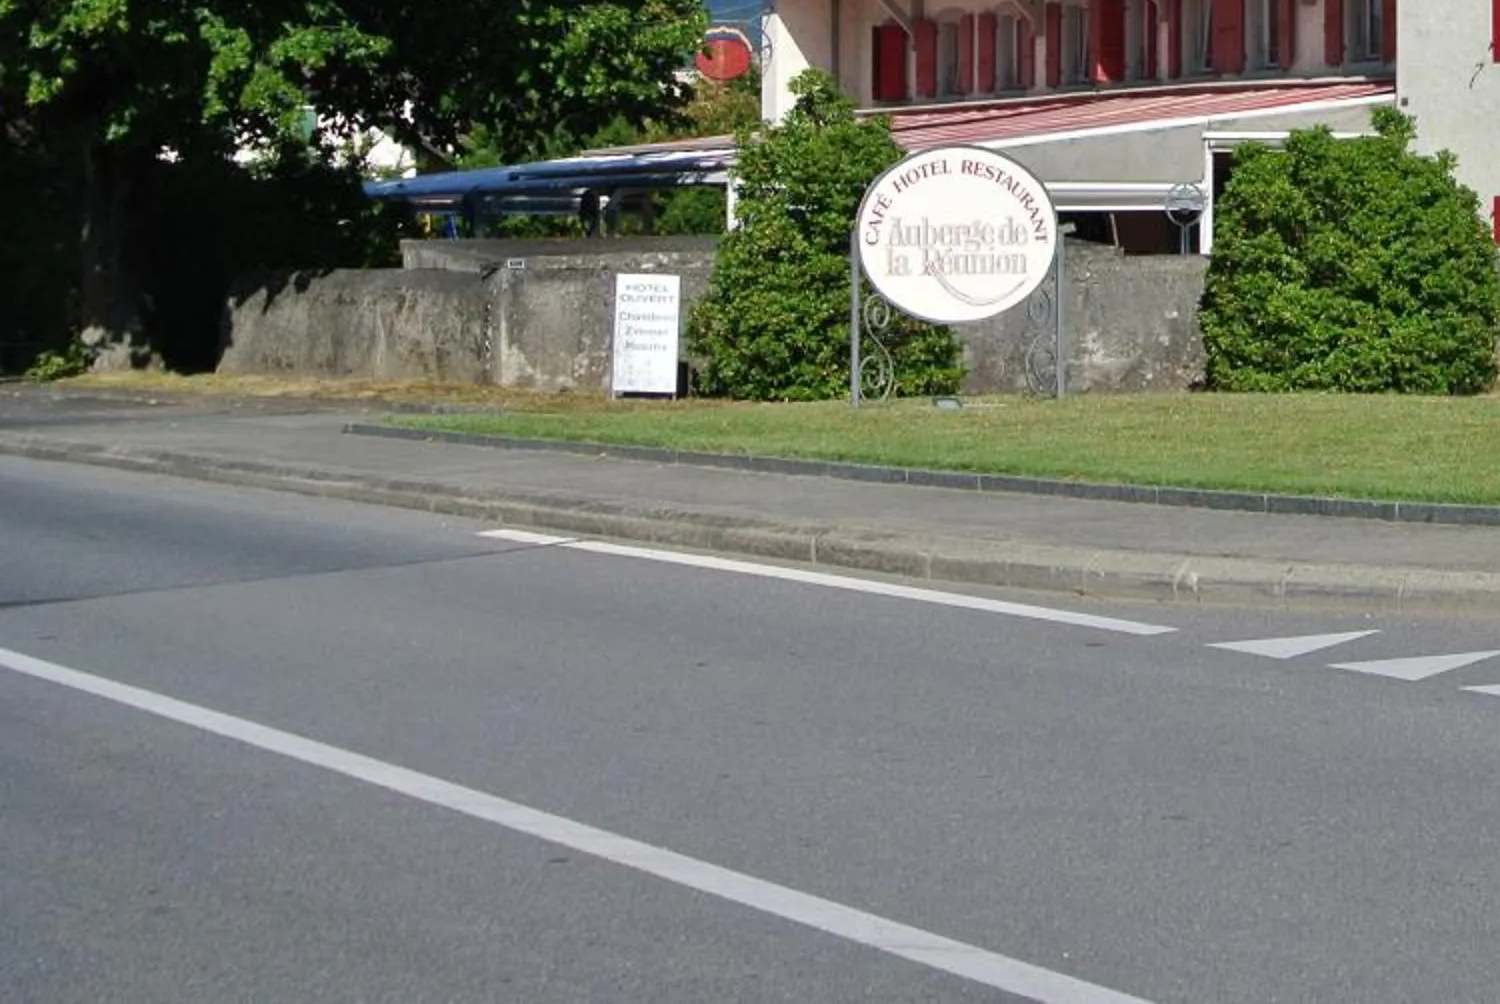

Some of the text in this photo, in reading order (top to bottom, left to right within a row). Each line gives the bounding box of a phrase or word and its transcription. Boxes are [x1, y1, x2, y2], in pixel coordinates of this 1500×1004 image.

[865, 158, 1049, 246] CAFÉ HOTEL RESTAURANT
[887, 216, 1029, 253] Auberge de
[884, 246, 1028, 277] la Réunion
[619, 294, 675, 303] OUVERT
[625, 283, 669, 293] HOTEL
